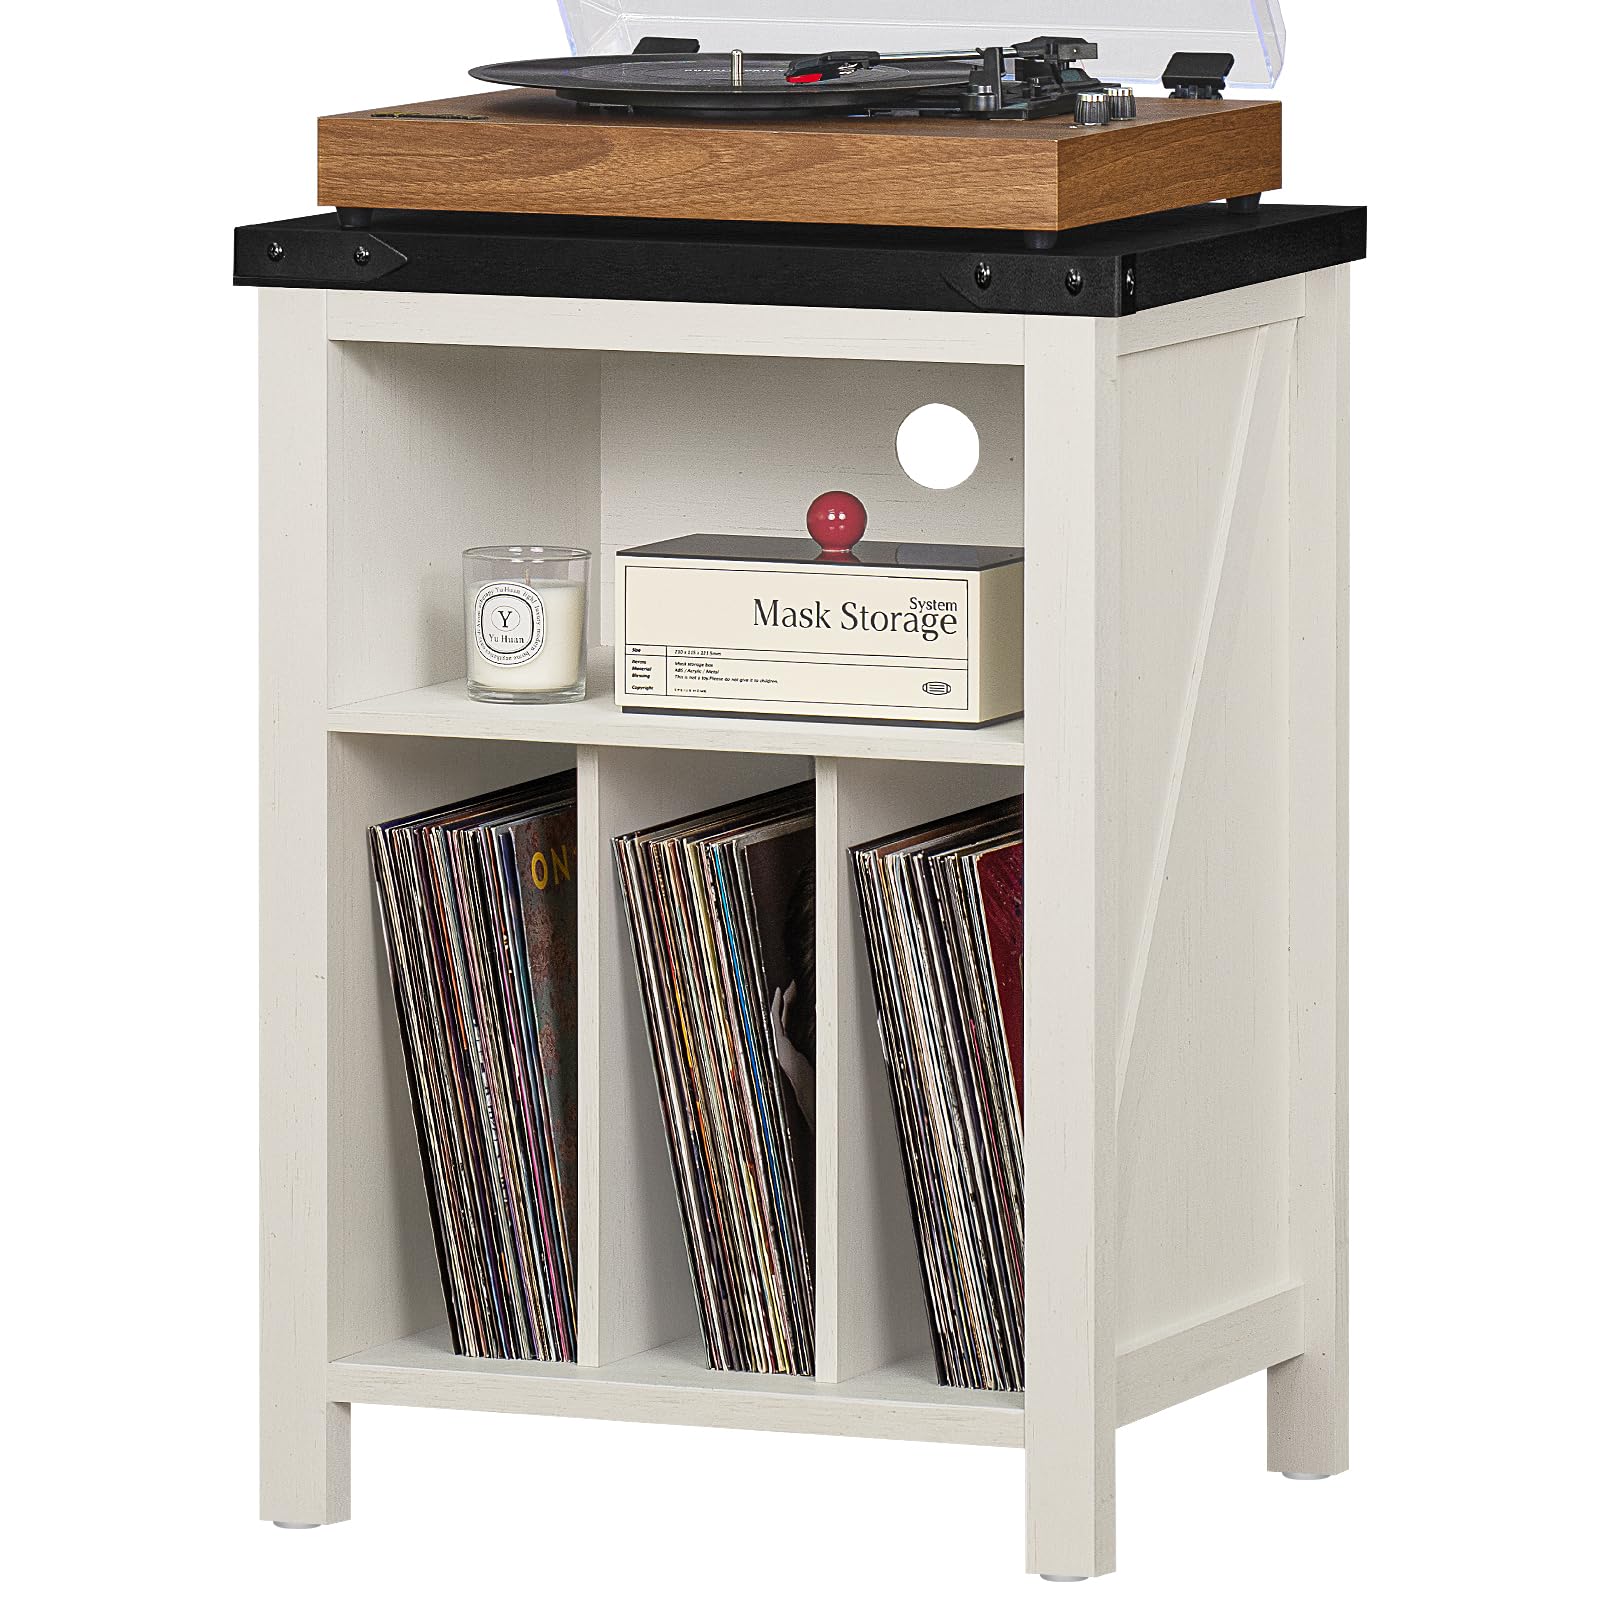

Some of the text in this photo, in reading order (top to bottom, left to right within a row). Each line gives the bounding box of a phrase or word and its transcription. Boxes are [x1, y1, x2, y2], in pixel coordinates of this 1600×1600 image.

[910, 596, 958, 613] System
[498, 610, 512, 628] Y
[753, 598, 958, 642] Mask Storage
[489, 634, 524, 643] Yu Huan
